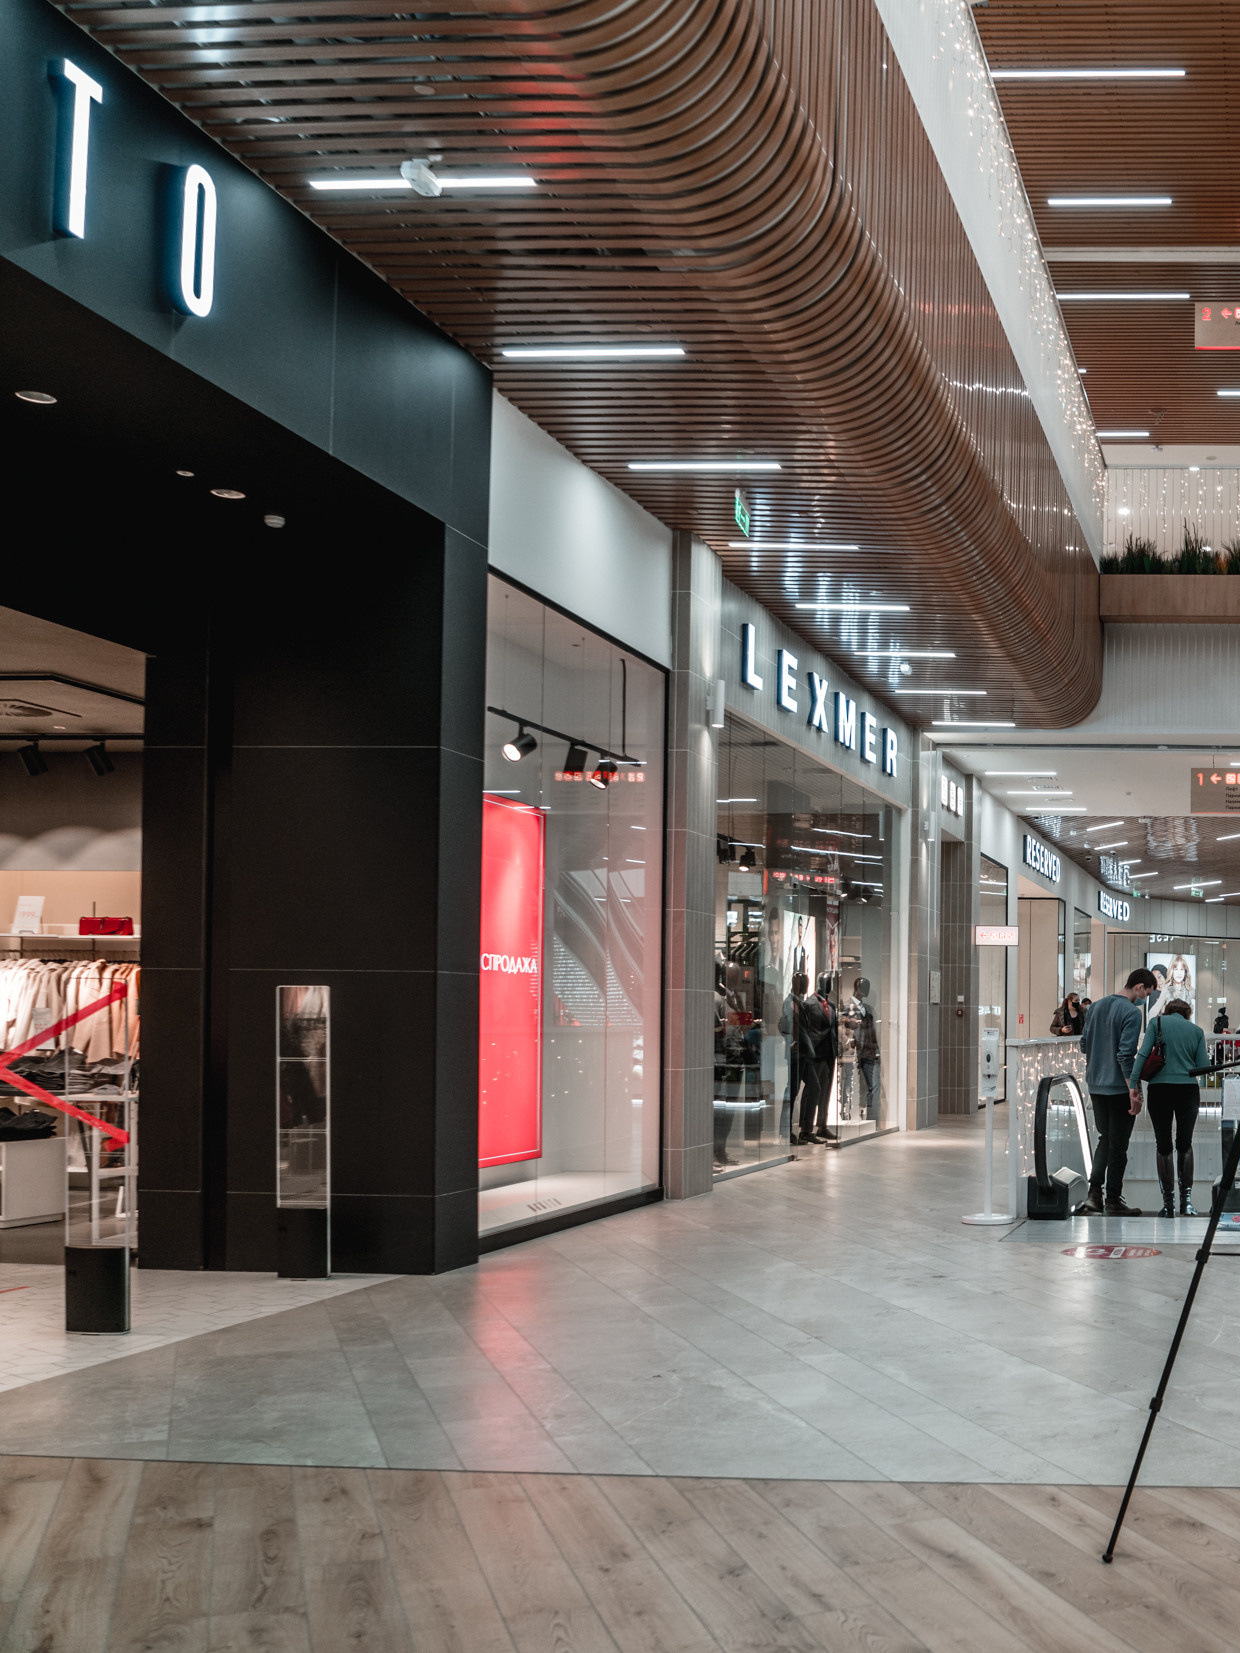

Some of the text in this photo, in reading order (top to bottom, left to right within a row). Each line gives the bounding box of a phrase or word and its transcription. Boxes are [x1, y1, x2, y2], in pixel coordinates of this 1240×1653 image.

[1202, 307, 1212, 321] 2
[744, 623, 898, 778] LEXMER
[1196, 772, 1203, 786] 1
[1025, 834, 1060, 883] RESERVED
[1099, 890, 1130, 922] RESERVED
